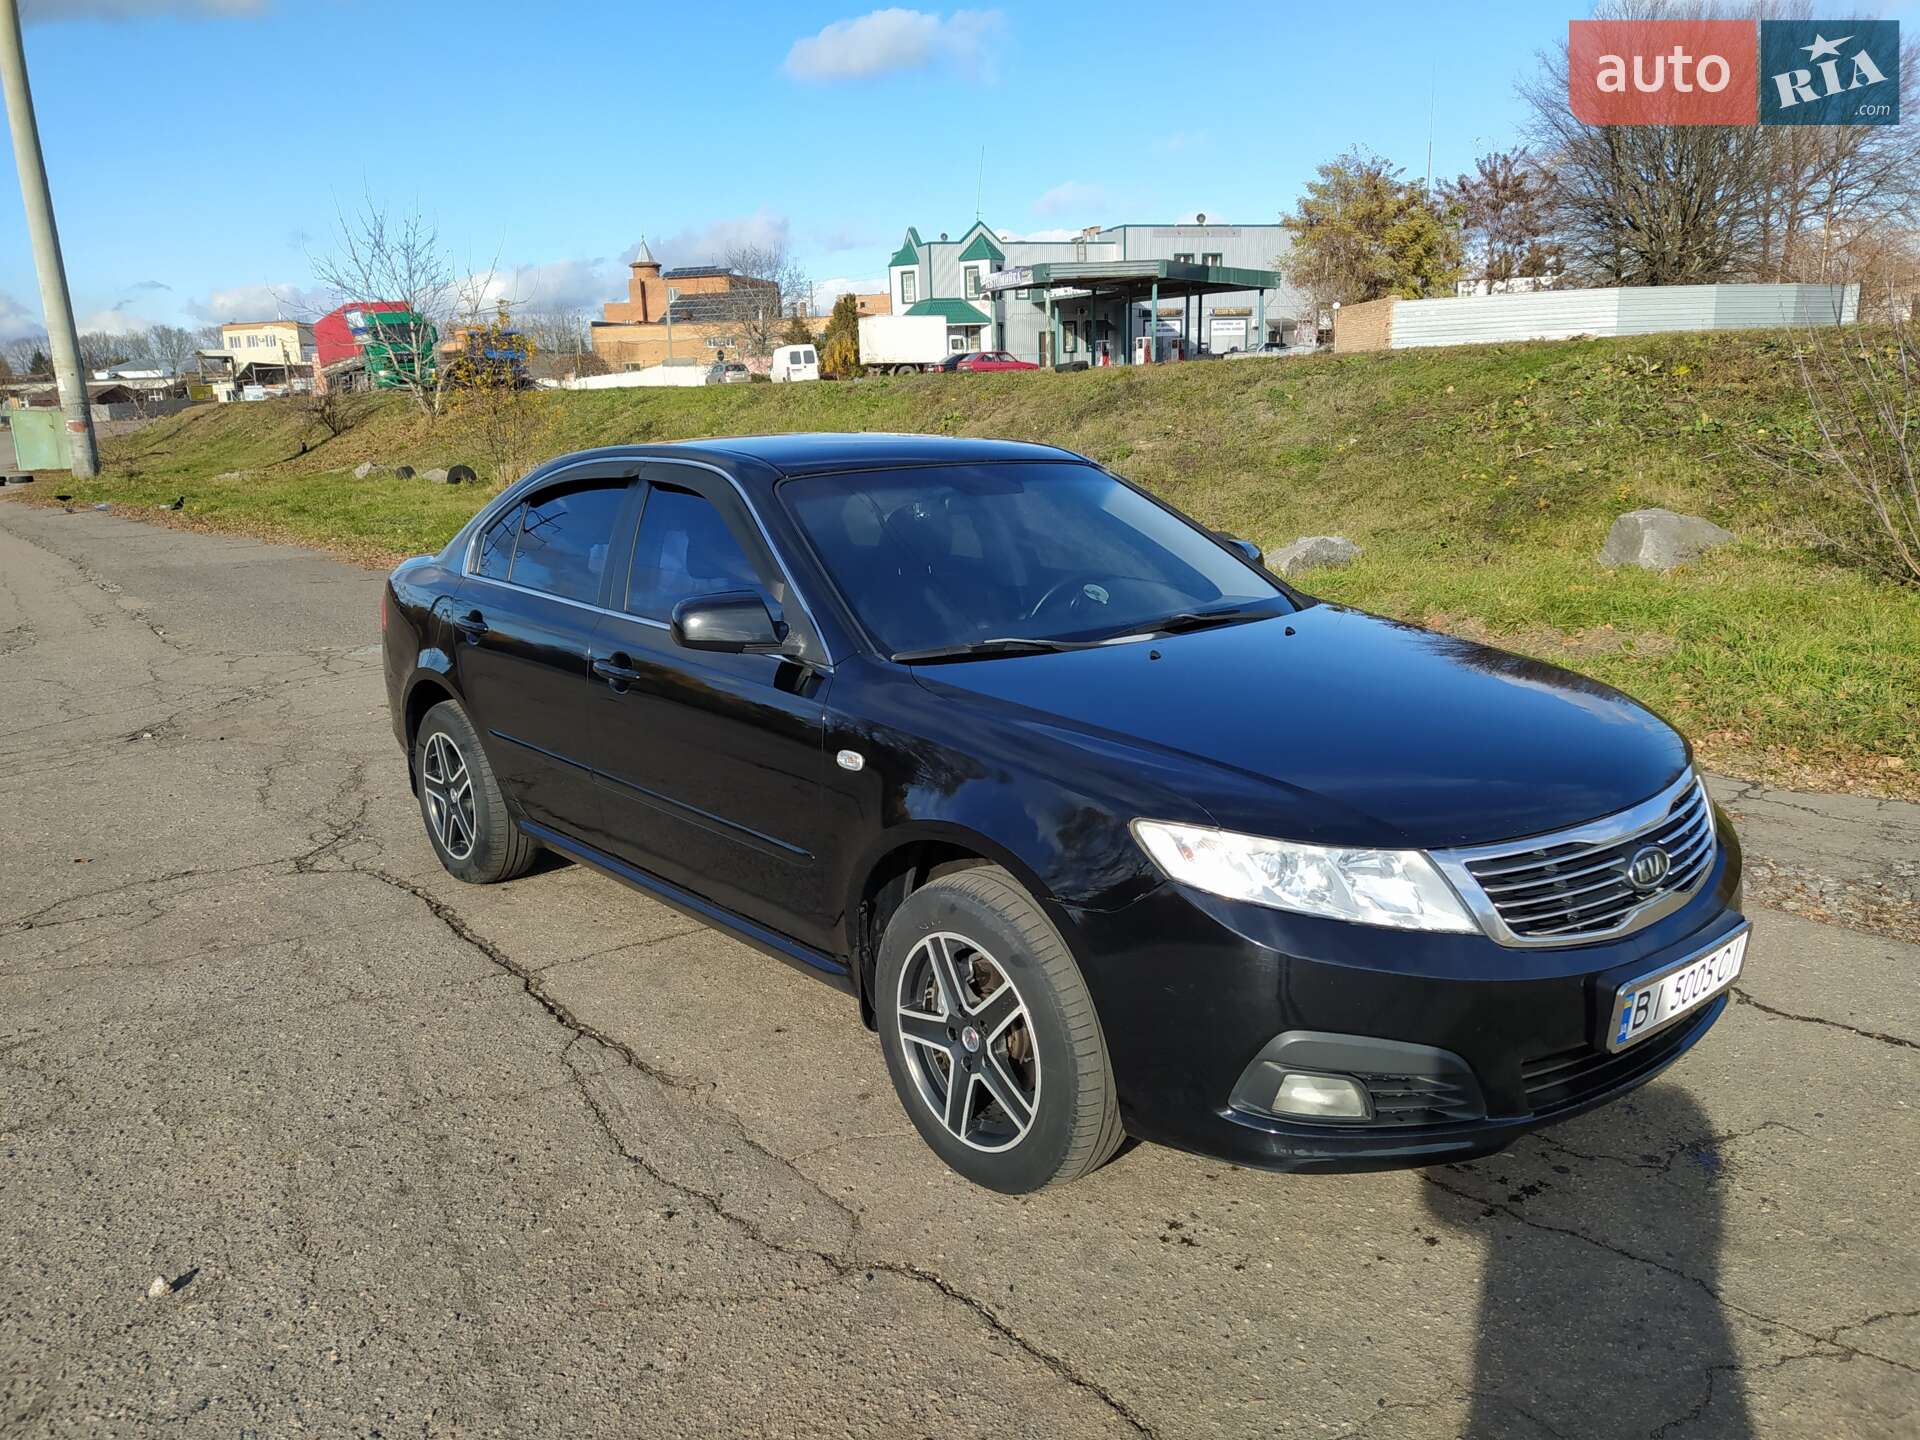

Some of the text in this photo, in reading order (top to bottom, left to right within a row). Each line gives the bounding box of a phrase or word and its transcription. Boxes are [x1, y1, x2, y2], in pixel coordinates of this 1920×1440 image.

[1634, 853, 1666, 882] KIA
[1632, 983, 1664, 1030] BI
[1670, 957, 1716, 1011] 5005
